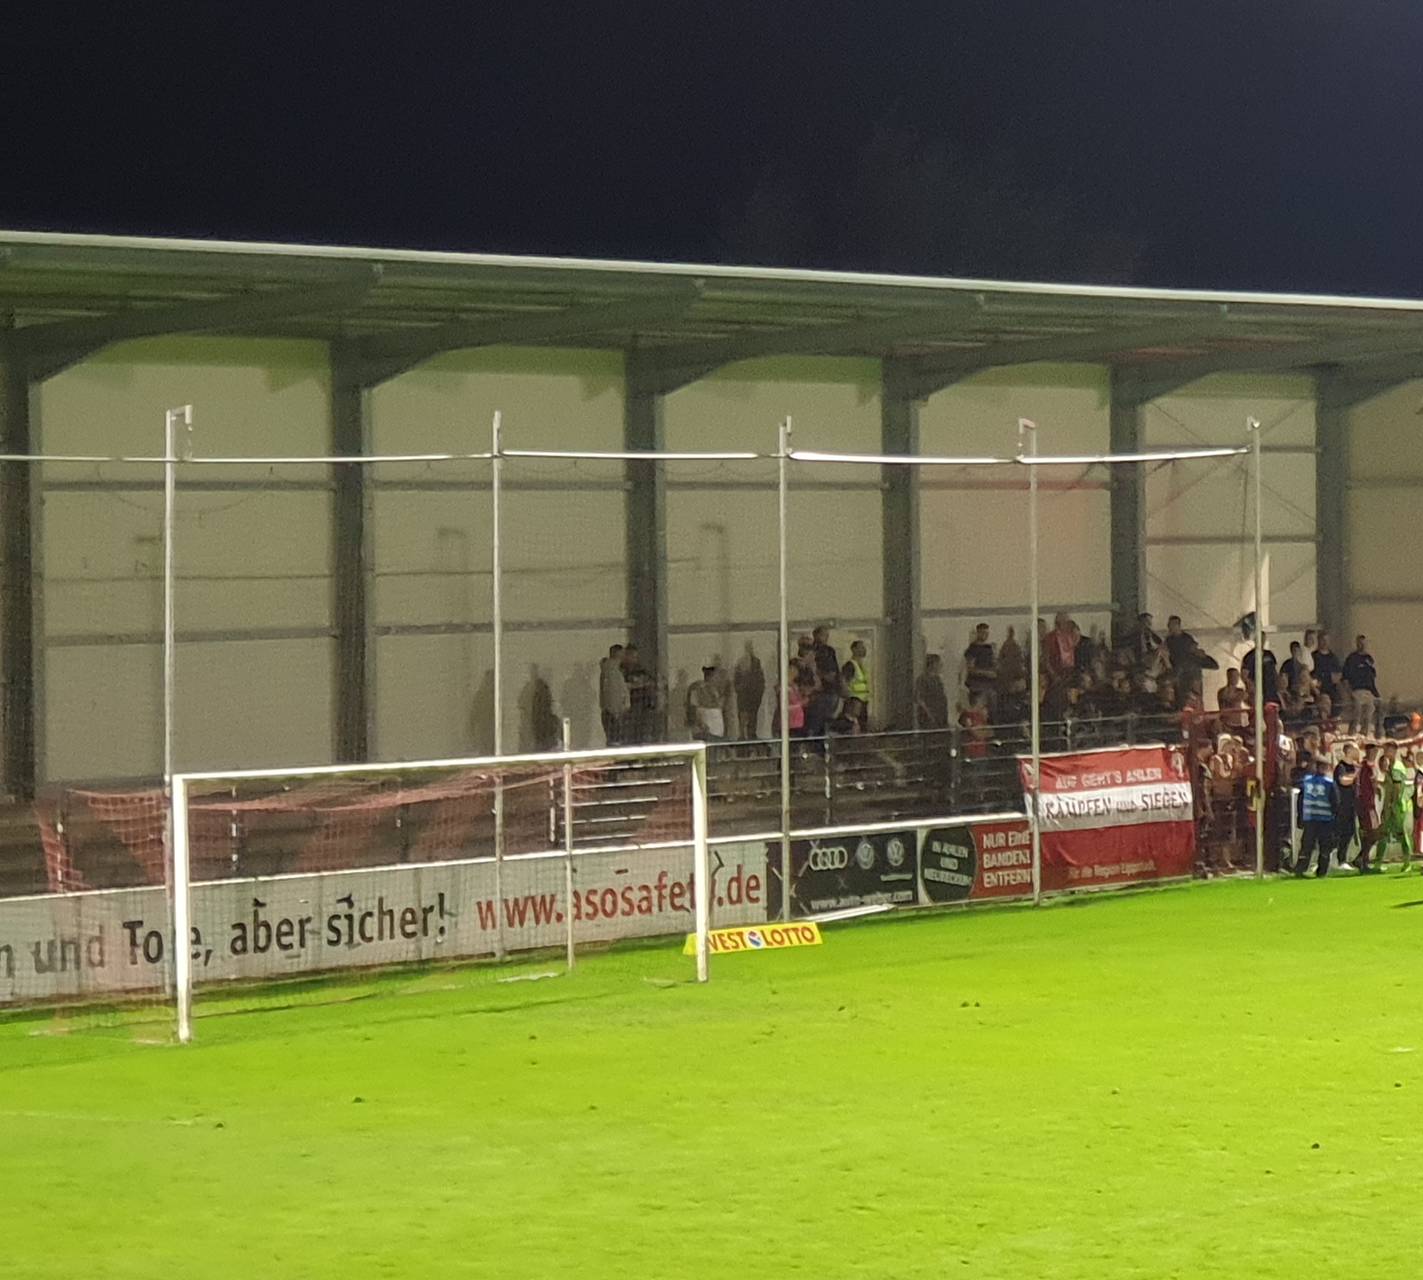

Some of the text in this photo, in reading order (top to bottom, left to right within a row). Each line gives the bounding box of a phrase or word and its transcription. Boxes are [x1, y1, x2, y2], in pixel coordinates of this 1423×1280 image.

[983, 832, 1006, 849] NUR
[31, 925, 105, 974] und
[122, 920, 212, 966] Toe,
[231, 909, 312, 956] aber
[327, 893, 446, 947] sicher!
[473, 864, 761, 931] www.asosafet.de
[761, 926, 815, 947] LOTTO
